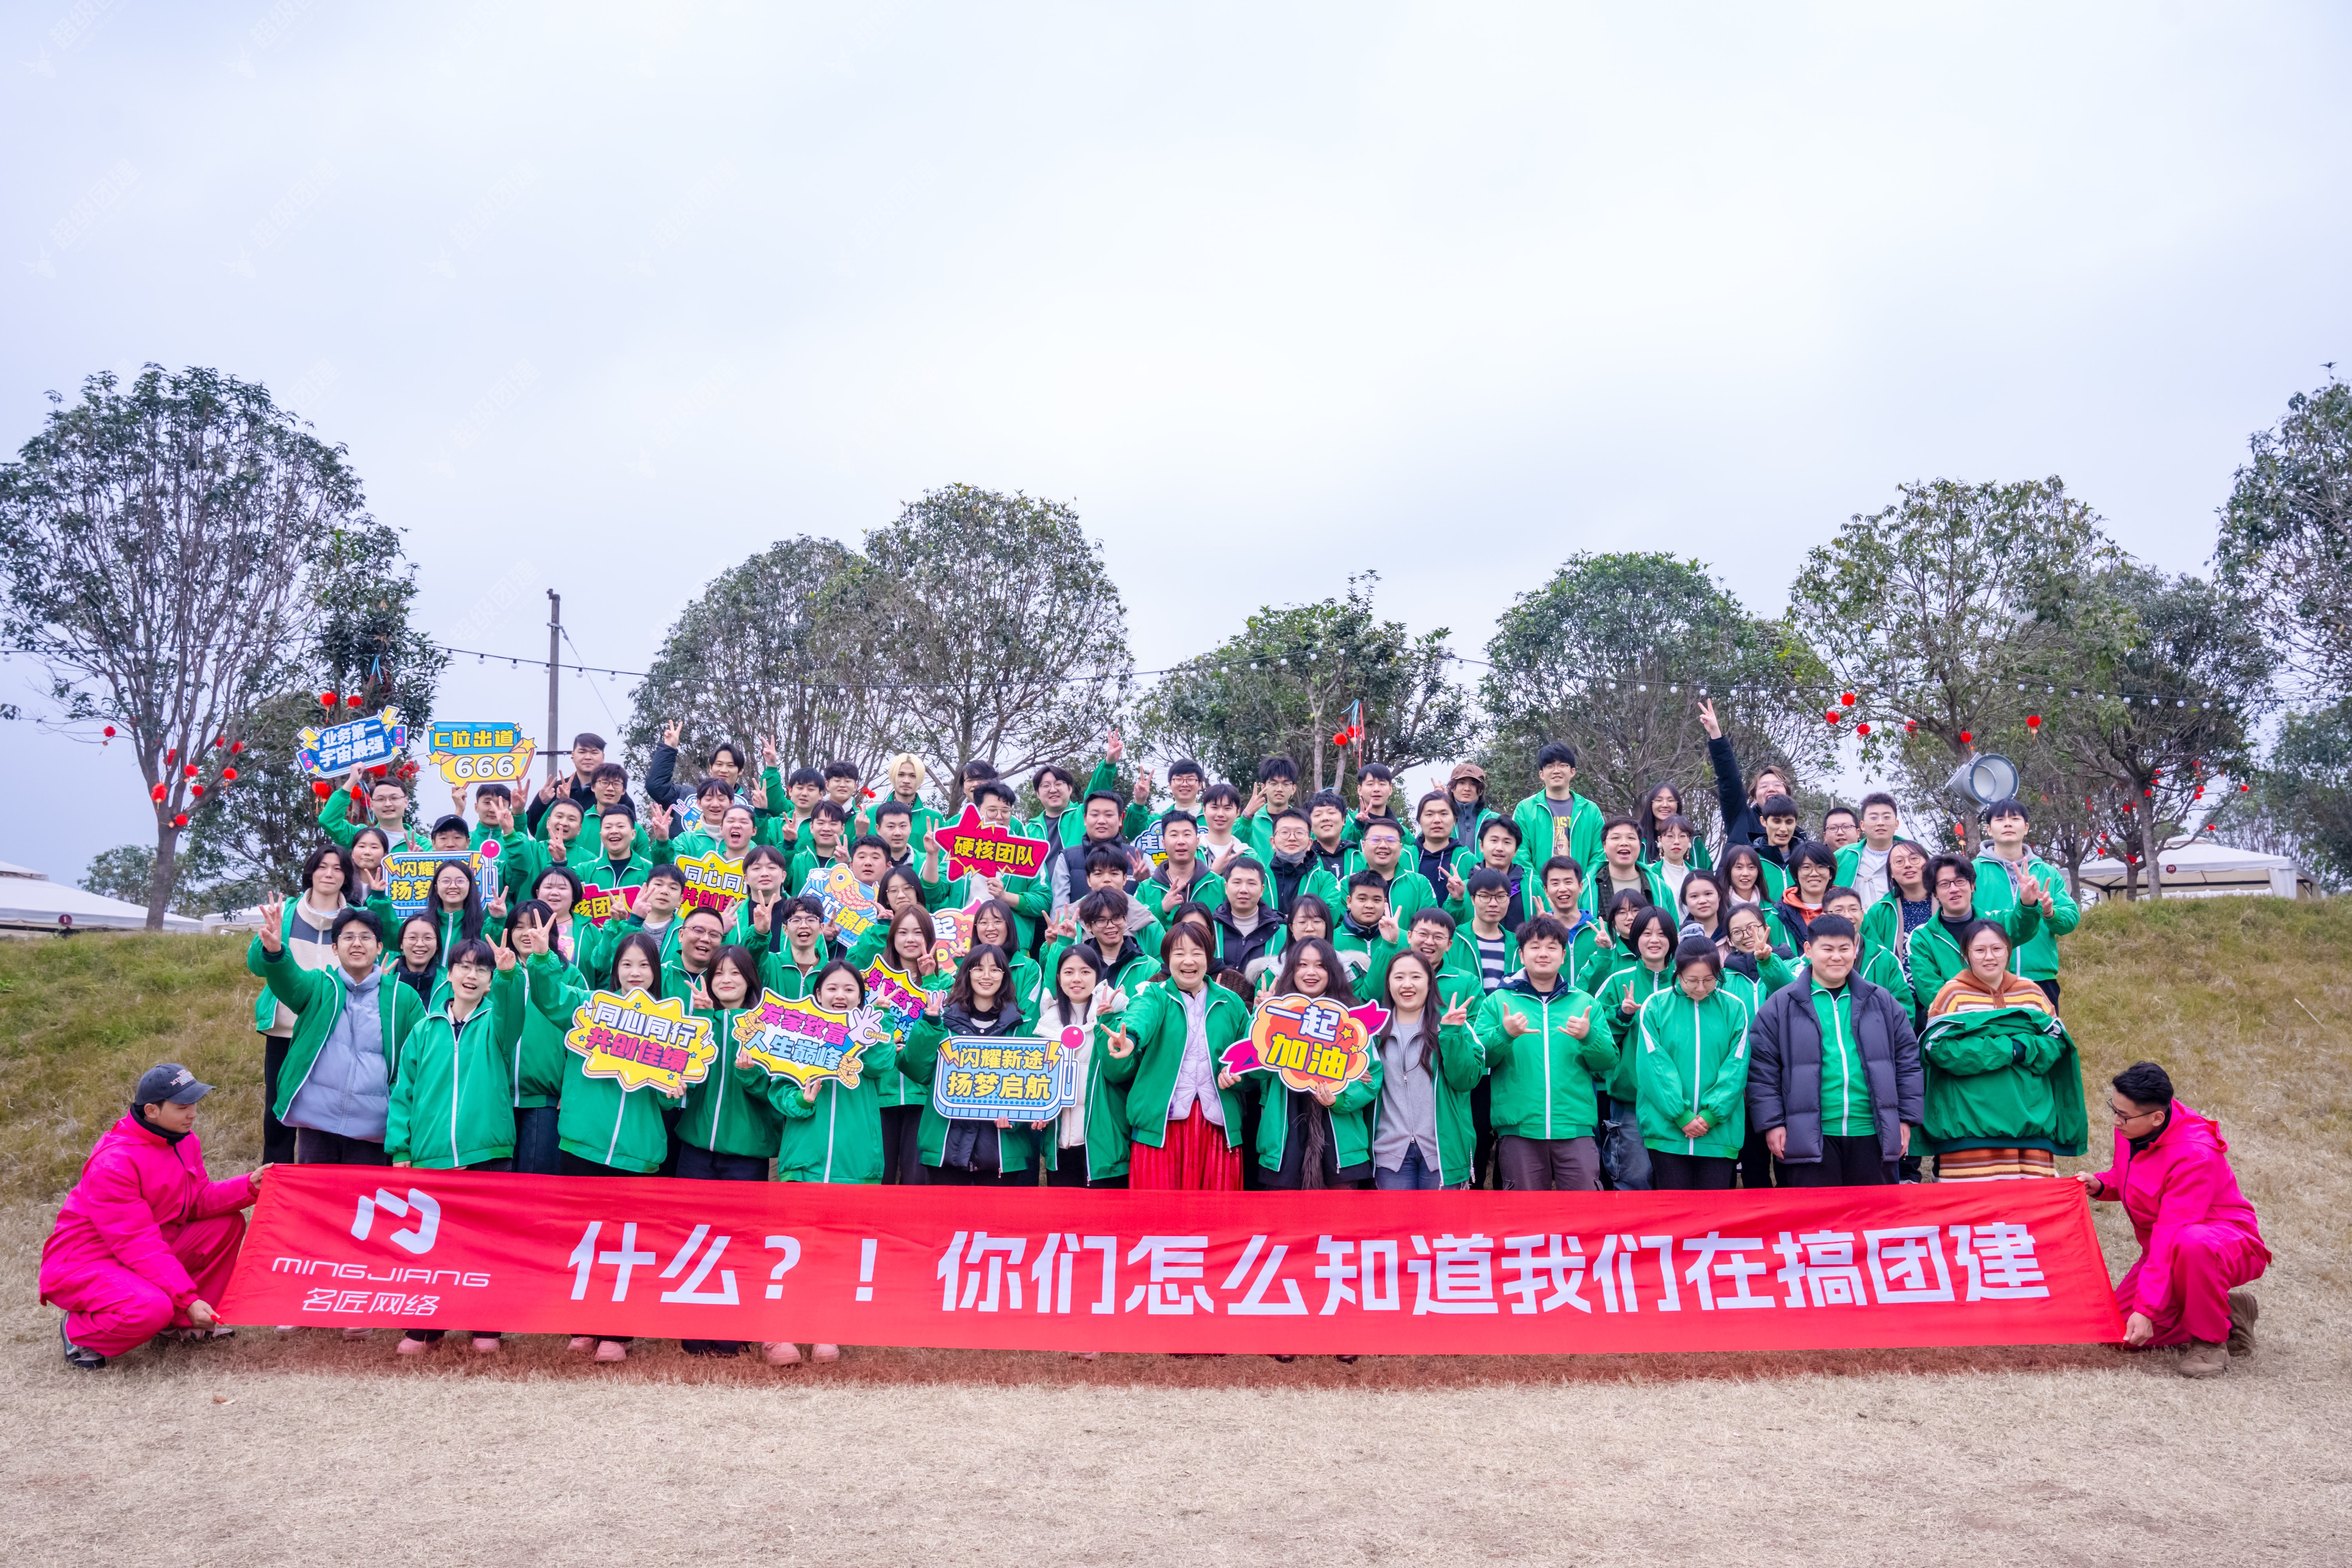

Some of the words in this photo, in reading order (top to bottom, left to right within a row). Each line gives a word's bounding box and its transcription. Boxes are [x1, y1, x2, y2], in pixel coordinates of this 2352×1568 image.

[319, 735, 385, 768] 宇宙最强
[322, 722, 381, 749] 业务第一
[434, 729, 514, 748] C位出道
[455, 755, 515, 778] 666
[953, 835, 1036, 868] 硬核团队
[593, 1001, 697, 1047] 同心同行
[759, 1002, 851, 1047] 发家致富
[1266, 1004, 1341, 1042] 一起
[585, 1027, 690, 1074] 共创佳绩
[744, 1034, 844, 1073] 人生巅峰
[960, 1048, 1044, 1070] 闪耀新途
[1266, 1033, 1350, 1081] 加油
[947, 1072, 1052, 1100] 扬梦启航
[272, 1257, 491, 1287] MINGJIANG
[302, 1287, 440, 1316] 名匠网络
